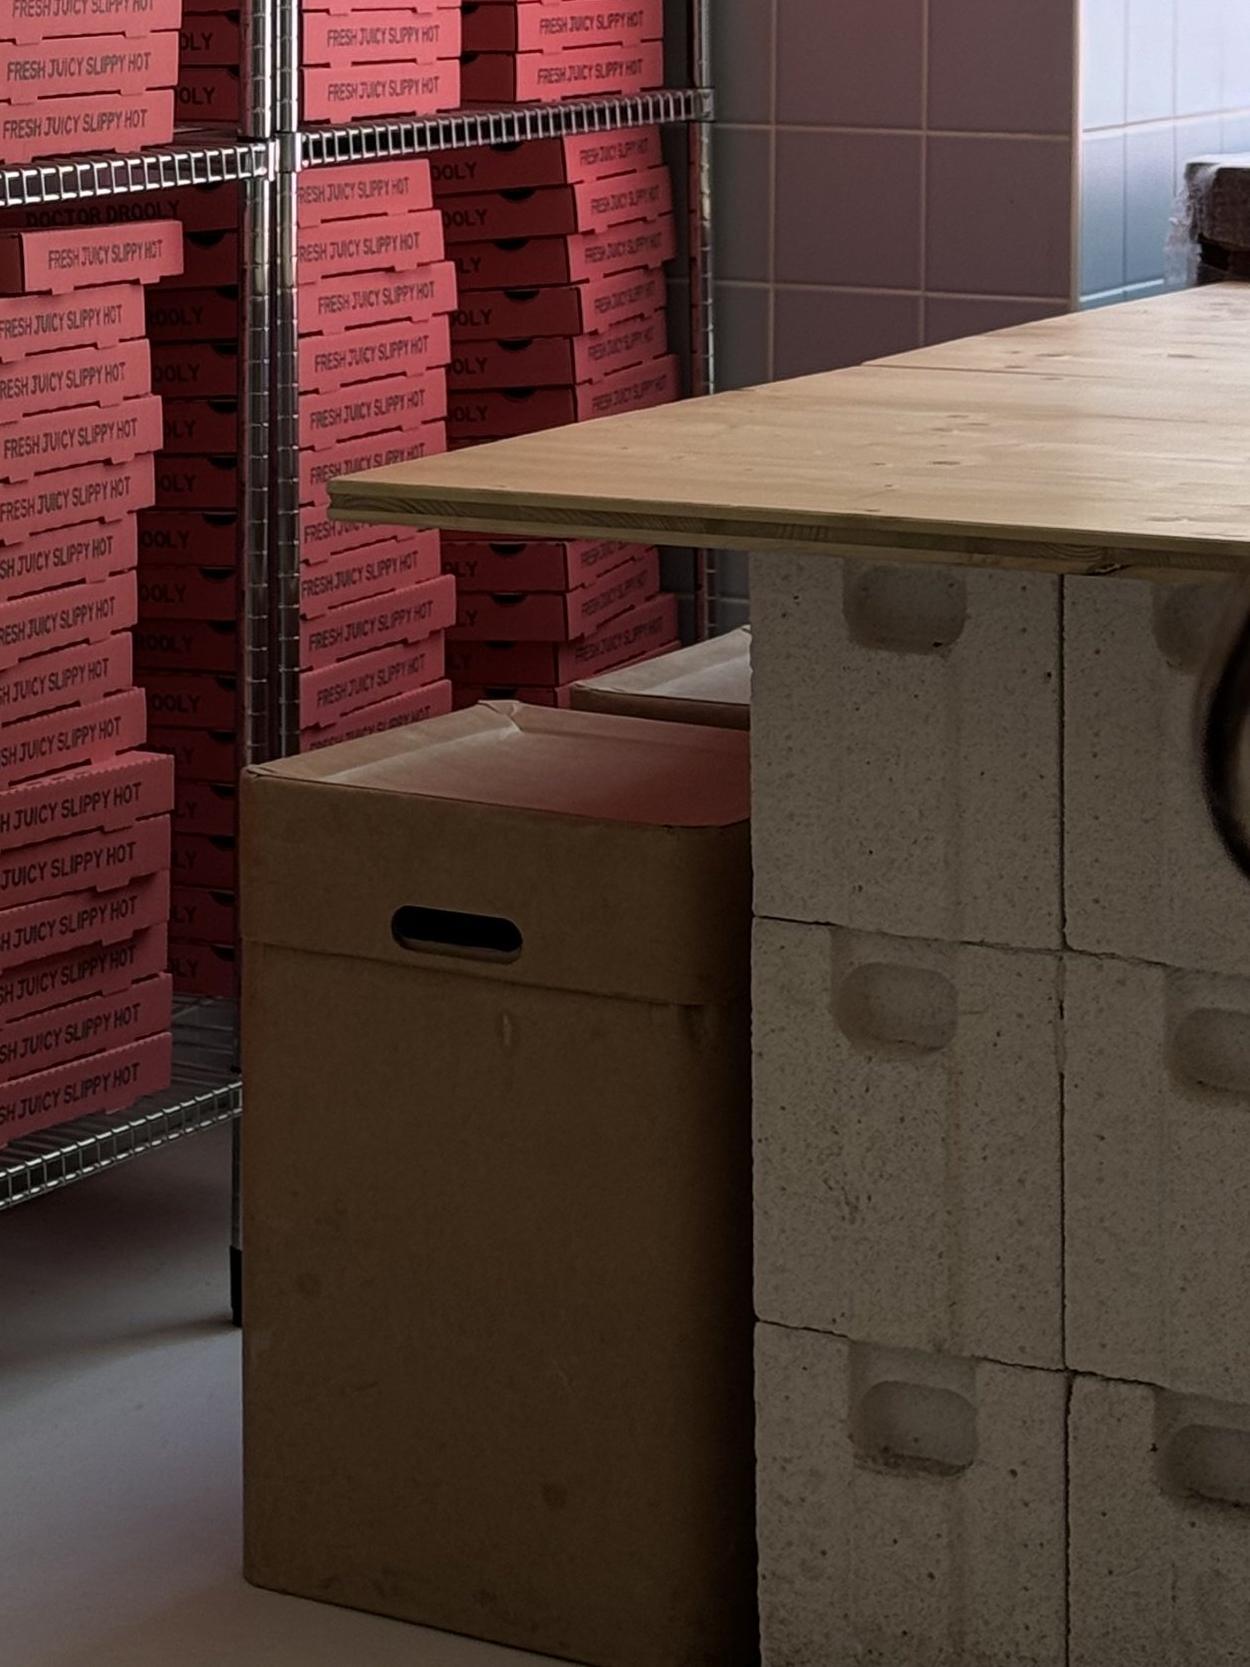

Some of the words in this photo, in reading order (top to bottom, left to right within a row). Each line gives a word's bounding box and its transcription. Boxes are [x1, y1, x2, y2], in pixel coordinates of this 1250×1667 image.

[327, 81, 359, 103] FRESH
[358, 80, 387, 100] JUICY
[388, 77, 420, 98] SLIPPY
[421, 75, 441, 95] HOT
[47, 247, 80, 270] FRESH
[81, 244, 110, 267] JUICY
[108, 240, 144, 264] SLIPPY
[144, 238, 163, 260] HOT
[317, 292, 351, 315] FRESH
[351, 289, 381, 311] JUICY
[382, 283, 416, 306] SLIPPY
[415, 280, 436, 300] HOT
[16, 550, 51, 577] JUICY
[52, 540, 91, 569] SLIPPY
[91, 535, 113, 559] HOT
[13, 801, 58, 831] JUICY
[61, 788, 111, 820] SLIPPY
[113, 781, 142, 807] HOT
[20, 1087, 61, 1119] JUICY
[63, 1072, 111, 1106] SLIPPY
[112, 1061, 141, 1089] HOT
